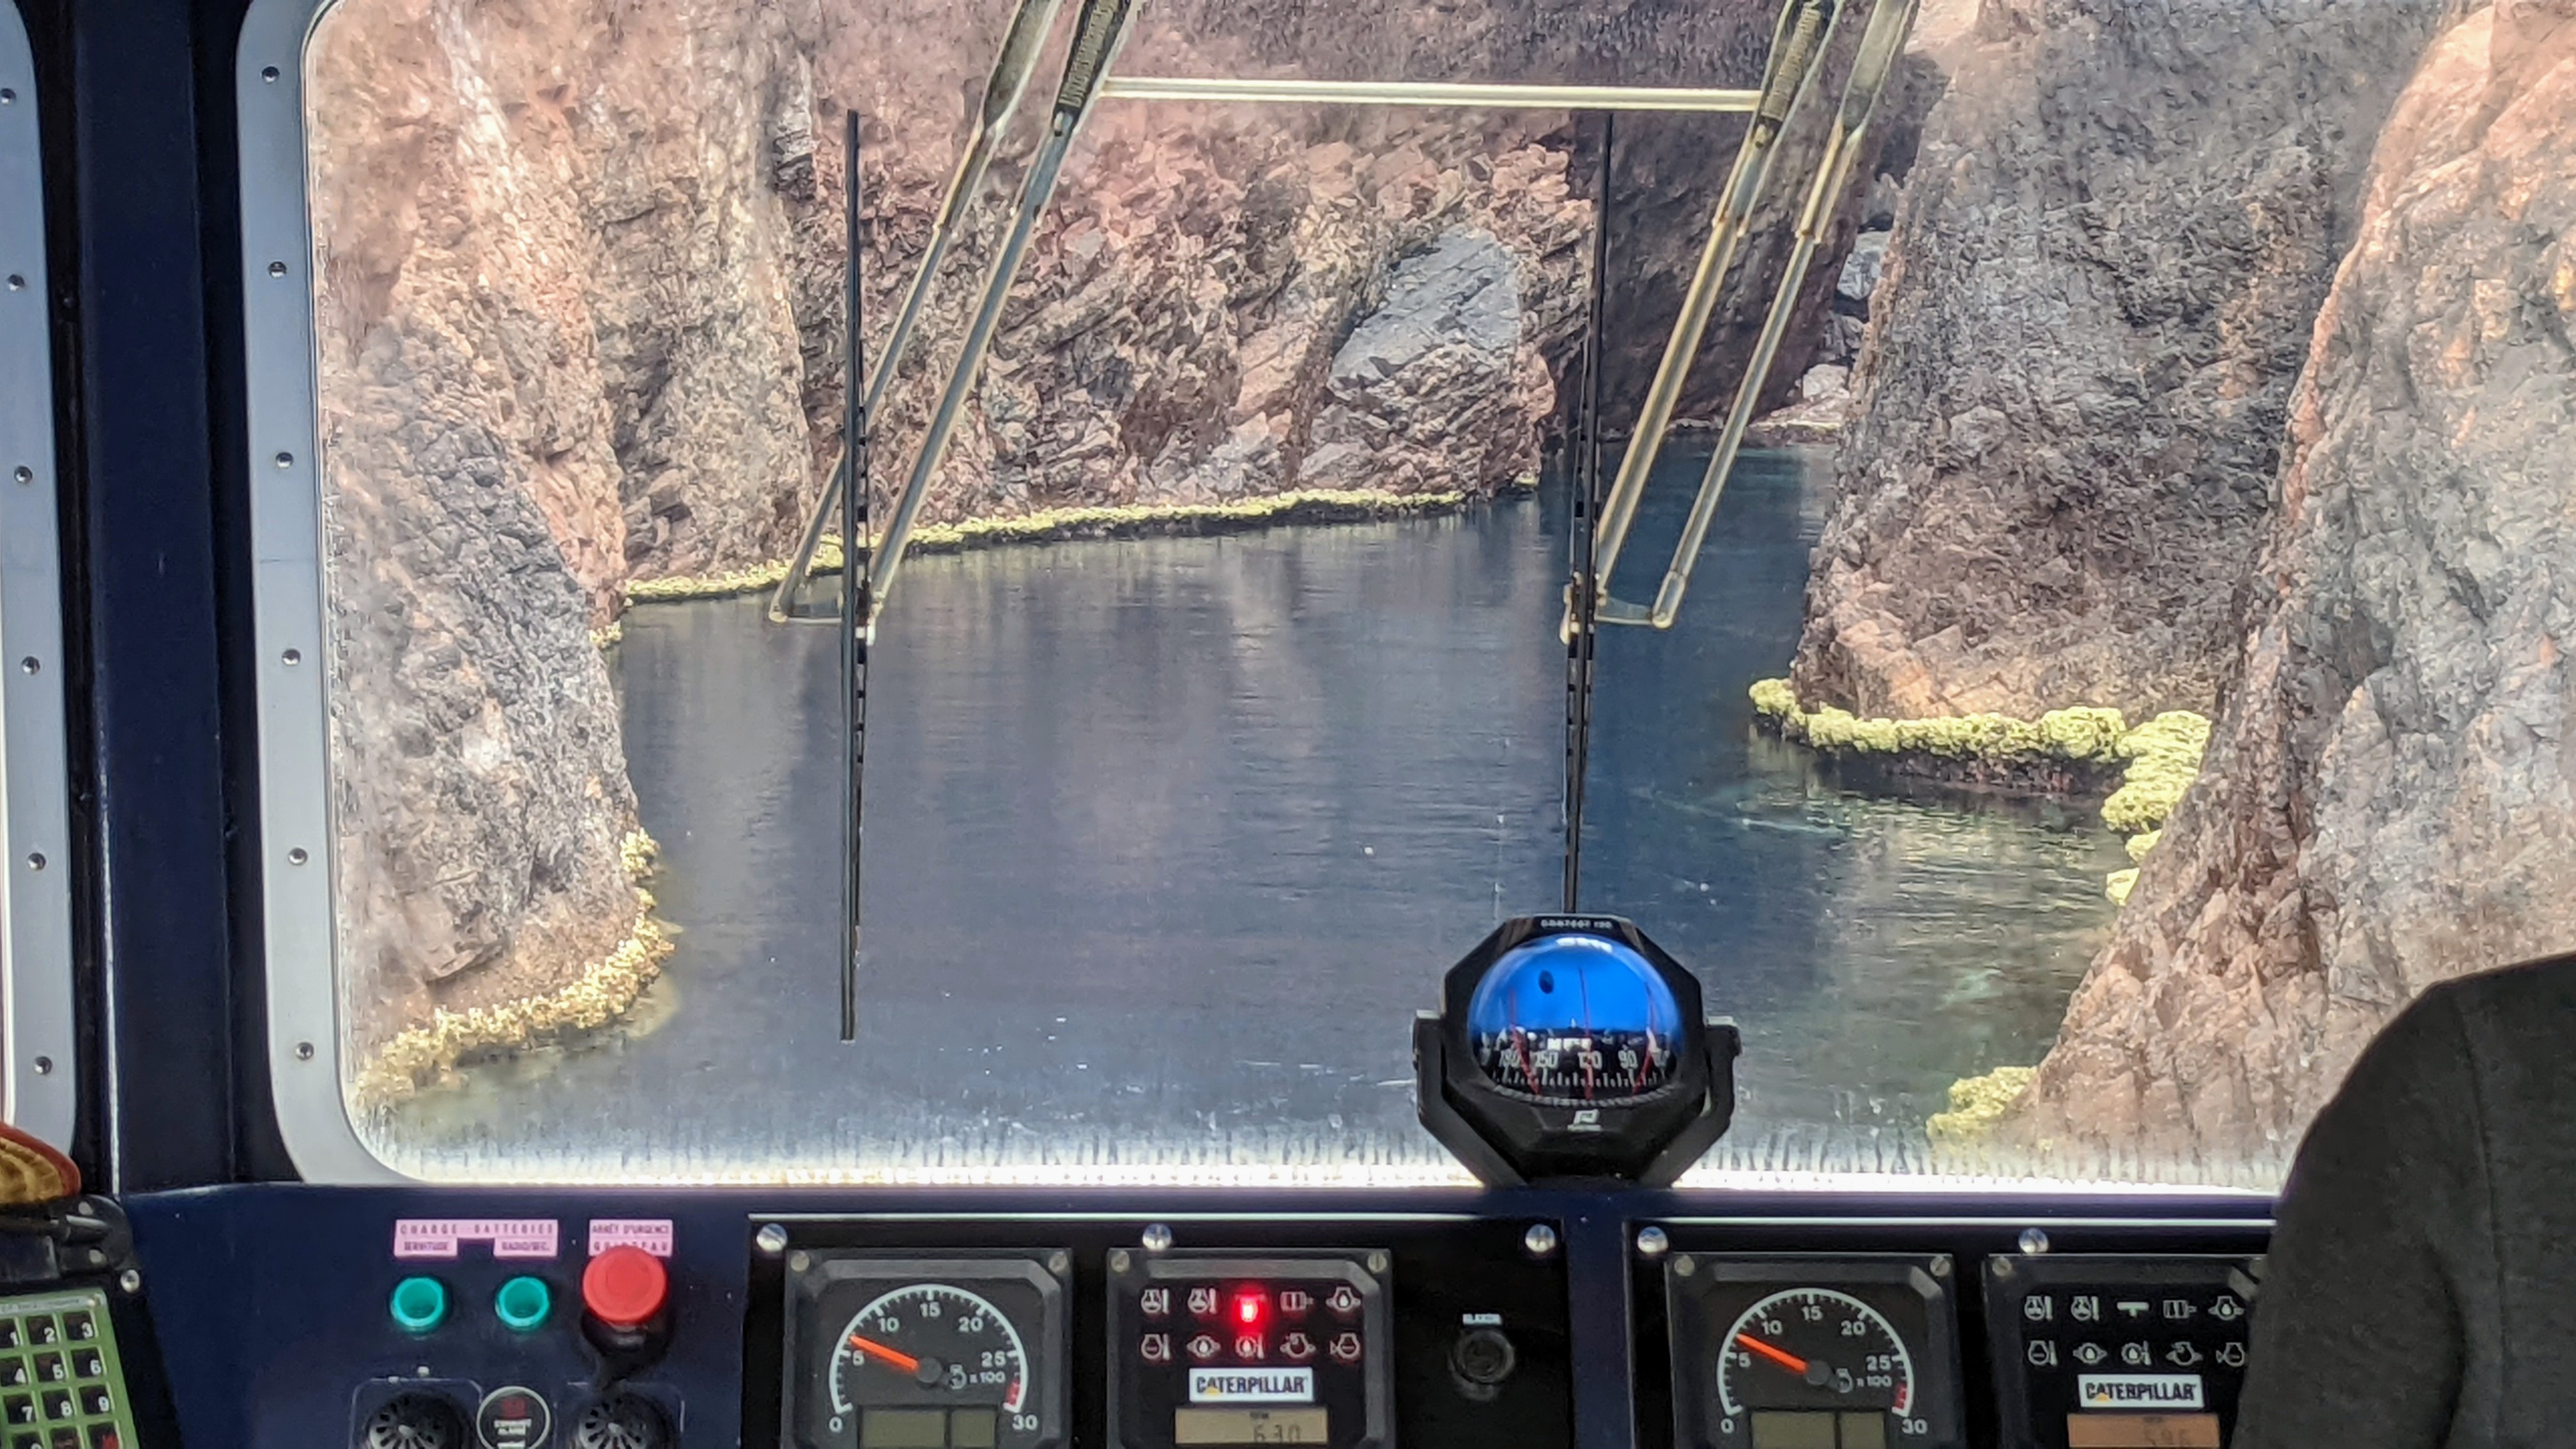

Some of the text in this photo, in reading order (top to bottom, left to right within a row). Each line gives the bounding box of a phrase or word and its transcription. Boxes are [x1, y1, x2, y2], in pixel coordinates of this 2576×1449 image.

[1618, 1050, 1638, 1070] 90
[400, 1223, 553, 1234] CHARGE BATTERIES
[920, 1303, 941, 1317] 15
[1801, 1307, 1823, 1322] 15
[878, 1317, 900, 1332] 10
[959, 1317, 983, 1332] 20
[1761, 1321, 1782, 1335] 10
[1841, 1321, 1866, 1336] 20
[10, 1322, 93, 1346] 1 2 3
[852, 1350, 864, 1366] 5
[981, 1350, 1006, 1368] 25
[1739, 1353, 1751, 1368] 5
[1866, 1356, 1892, 1372] 25
[15, 1360, 101, 1383] 4 5 6
[979, 1371, 1006, 1383] 100
[1196, 1376, 1305, 1393] CATERPILLAR
[1866, 1376, 1892, 1388] 100
[2085, 1382, 2195, 1400] CATERPILLAR
[22, 1396, 109, 1422] 7 8 9
[829, 1416, 843, 1432] 0
[1012, 1414, 1038, 1430] 30
[1721, 1419, 1735, 1434] 0
[1901, 1419, 1928, 1434] 30
